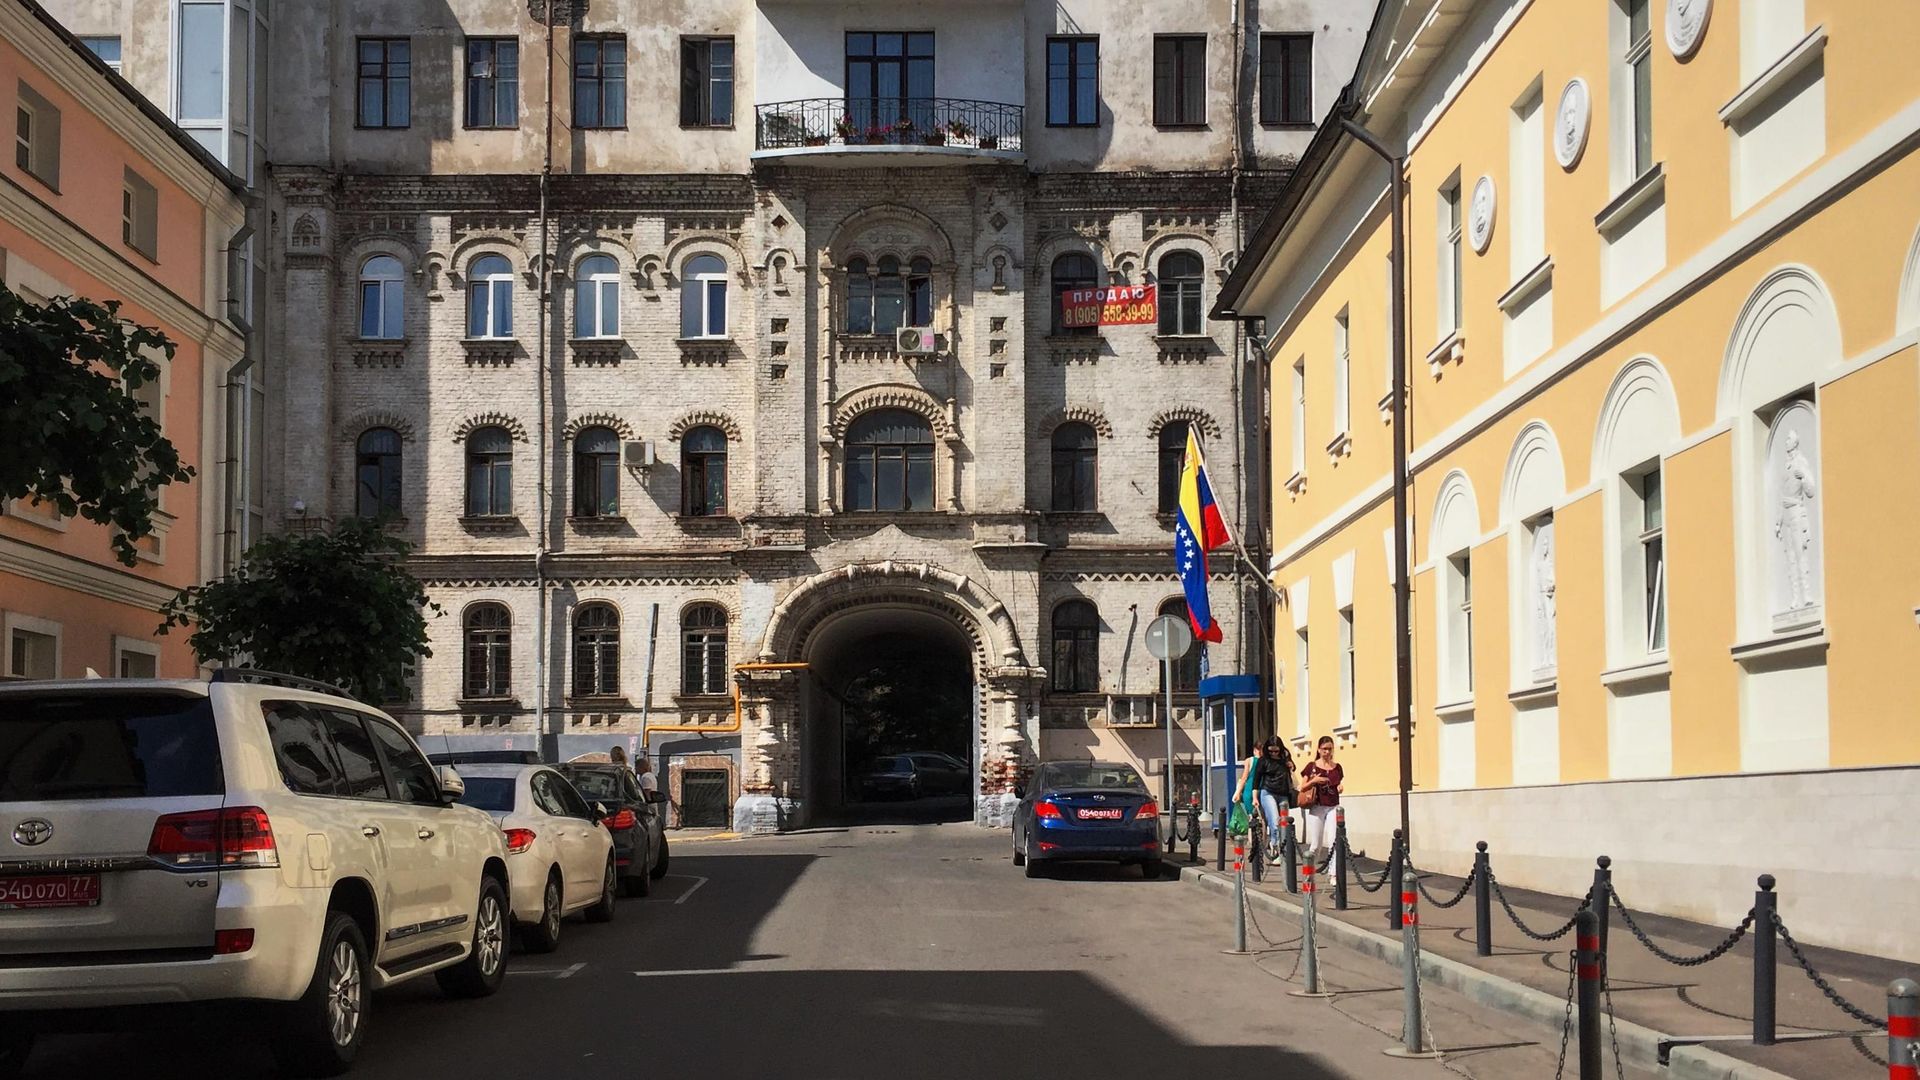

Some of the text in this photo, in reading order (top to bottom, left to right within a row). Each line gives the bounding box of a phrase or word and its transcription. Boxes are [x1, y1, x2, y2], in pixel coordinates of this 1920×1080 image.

[1073, 288, 1145, 303] ПРОДАЮ
[1065, 303, 1154, 325] 8 (905) 558-39-99
[71, 876, 91, 892] 77
[186, 878, 209, 888] V8
